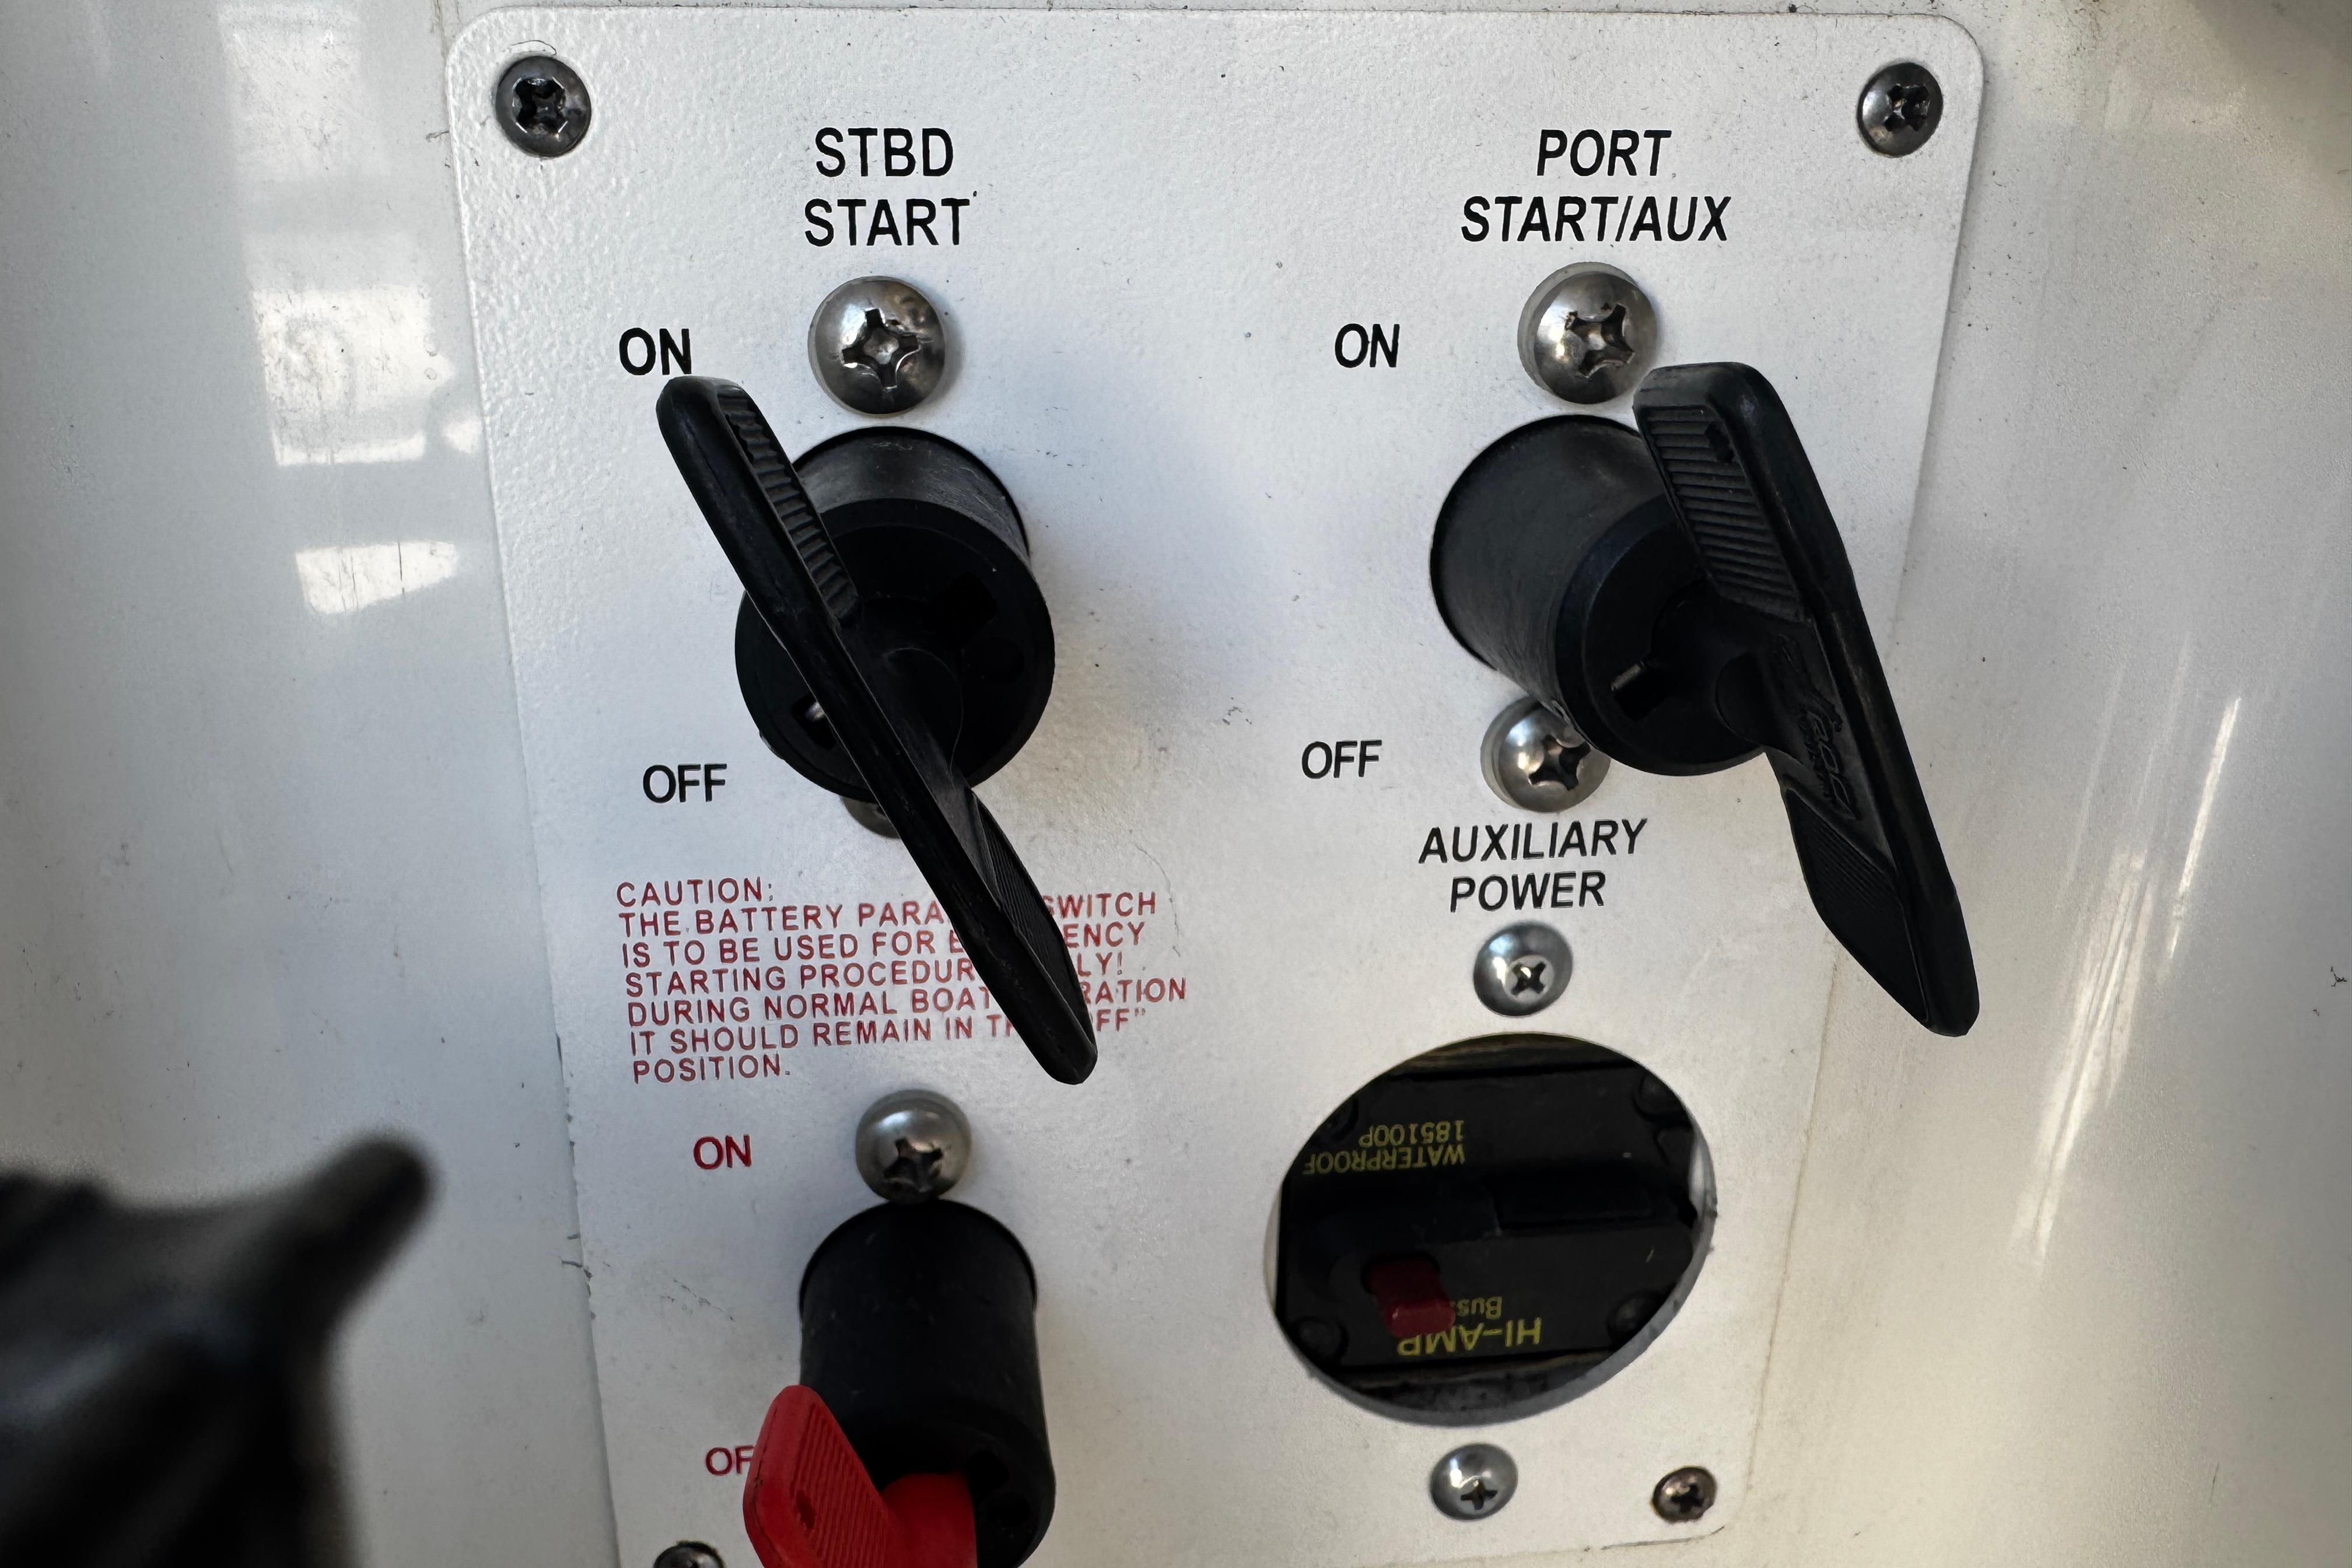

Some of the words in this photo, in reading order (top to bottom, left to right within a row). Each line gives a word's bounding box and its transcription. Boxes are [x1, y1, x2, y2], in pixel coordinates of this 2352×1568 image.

[816, 127, 954, 177] STBD
[1536, 129, 1672, 176] PORT
[804, 198, 971, 246] START
[1461, 195, 1731, 242] START/AUX
[619, 328, 692, 376] ON
[1334, 323, 1400, 368] ON
[1301, 739, 1382, 779] OFF
[642, 763, 727, 803] OFF
[1418, 818, 1647, 864] AUXILIARY
[1450, 870, 1606, 913] POWER
[618, 911, 681, 937] THE
[695, 904, 843, 935] BATTERY
[858, 900, 946, 928] PARA
[622, 942, 650, 969] IS
[663, 940, 705, 966] TO
[719, 937, 760, 964] BE
[774, 933, 858, 961] USED
[872, 929, 936, 957] FOR
[625, 966, 786, 998] STARTING
[800, 957, 975, 991] PROCEDUR
[628, 995, 750, 1028] DURING
[764, 990, 897, 1021] NORMAL
[911, 986, 991, 1013] BOAT
[1080, 977, 1186, 1005] RATION
[631, 1030, 655, 1056] IT
[670, 1024, 799, 1054] SHOULD
[813, 1018, 932, 1048] REMAIN
[945, 1016, 972, 1040] IN
[634, 1052, 790, 1084] POSITION.
[693, 1134, 752, 1170] ON
[1359, 1119, 1465, 1148] 185100P
[1302, 1143, 1465, 1175] WATERPROOF
[1396, 1317, 1542, 1357] HI-AMP
[706, 1444, 756, 1475] OF
